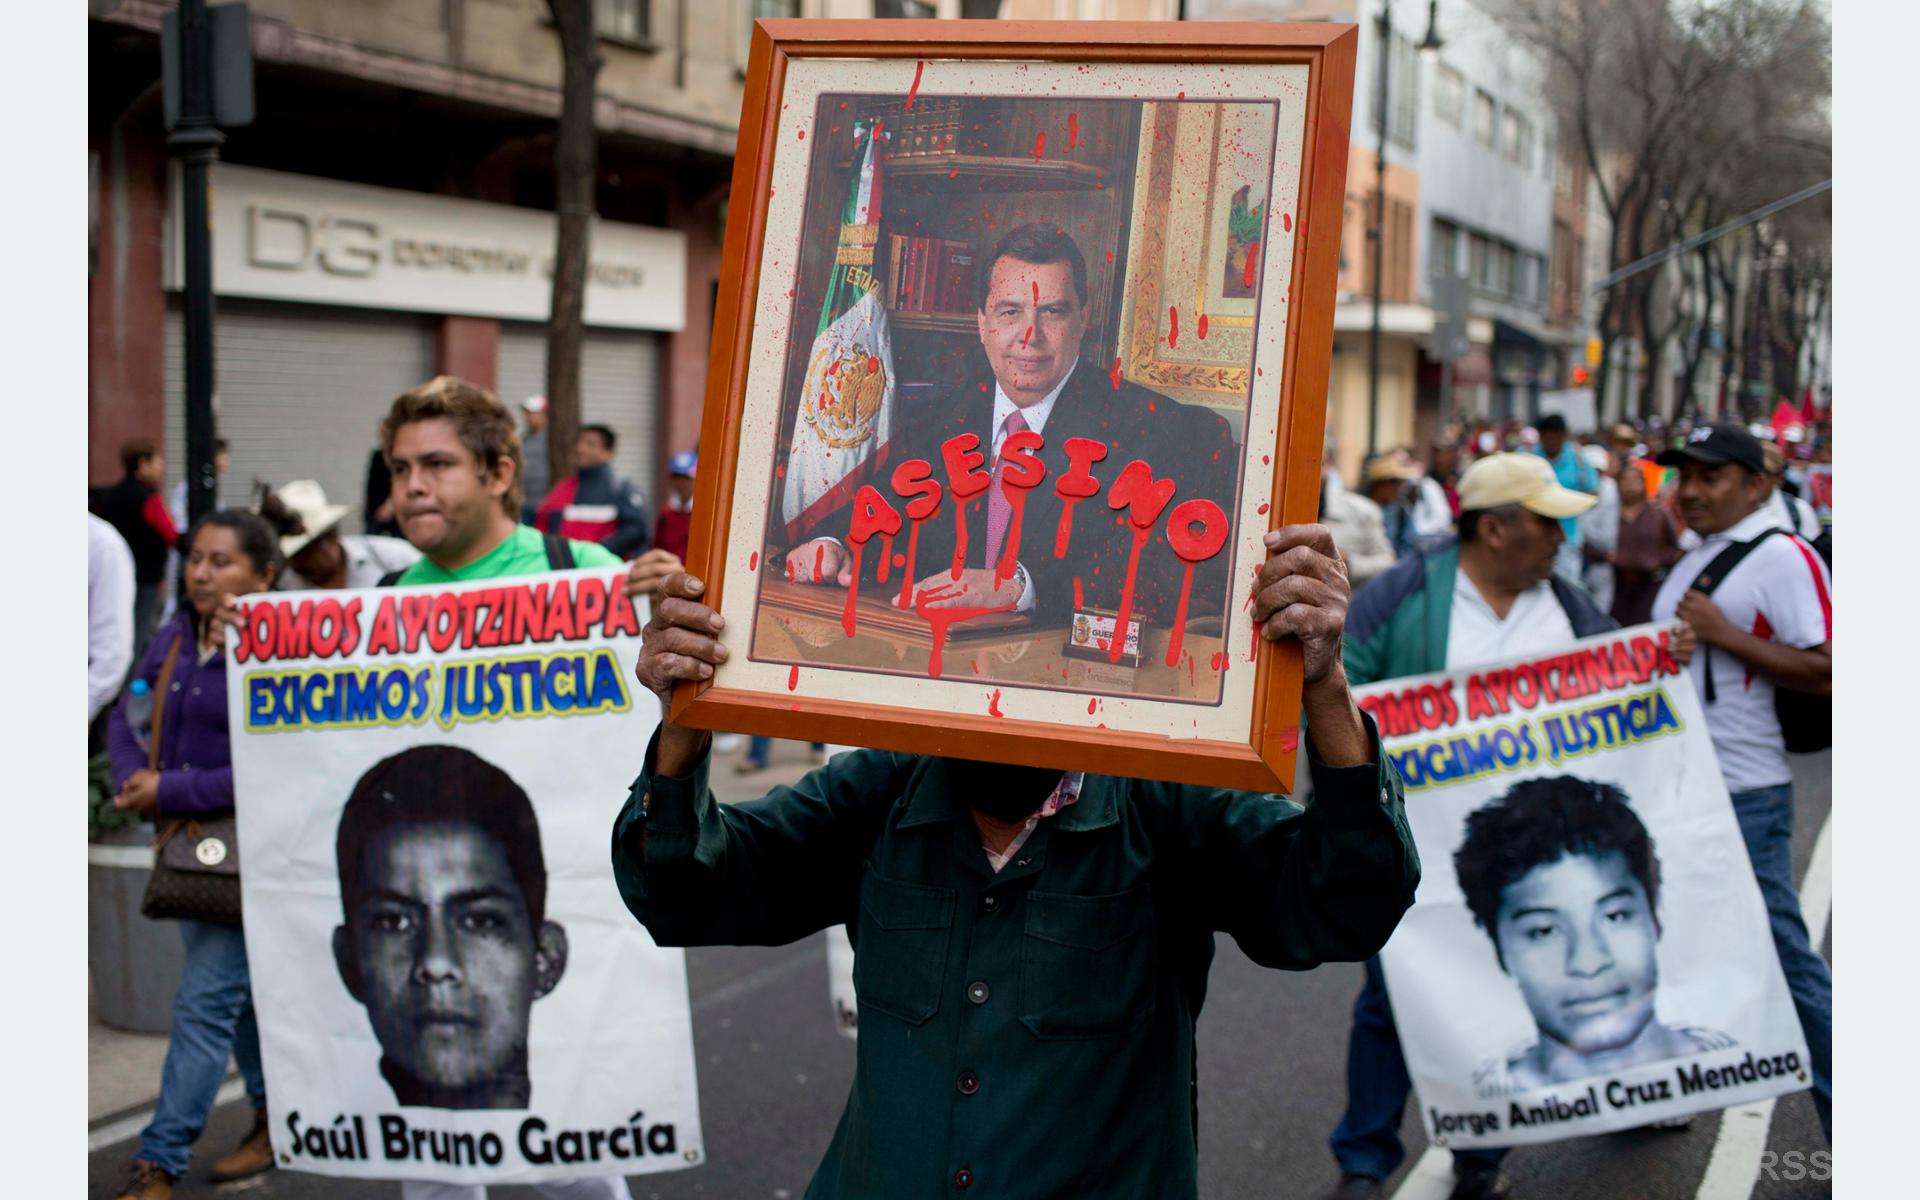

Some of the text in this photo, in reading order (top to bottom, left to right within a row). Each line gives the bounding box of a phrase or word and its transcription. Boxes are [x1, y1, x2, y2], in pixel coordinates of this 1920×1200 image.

[848, 430, 1229, 562] ASESINO
[367, 573, 641, 656] AYOTZINAPA
[246, 652, 627, 728] EXIGIMOS JUSTICIA
[1466, 629, 1681, 722] AYOTZINAPA
[1388, 690, 1680, 788] XIGIMOS JUSTICIA
[1429, 1106, 1501, 1137] Jorge
[1606, 1077, 1674, 1109] Cruz
[1675, 1051, 1800, 1096] Mendoza
[286, 1110, 677, 1166] Saúl Bruno García
